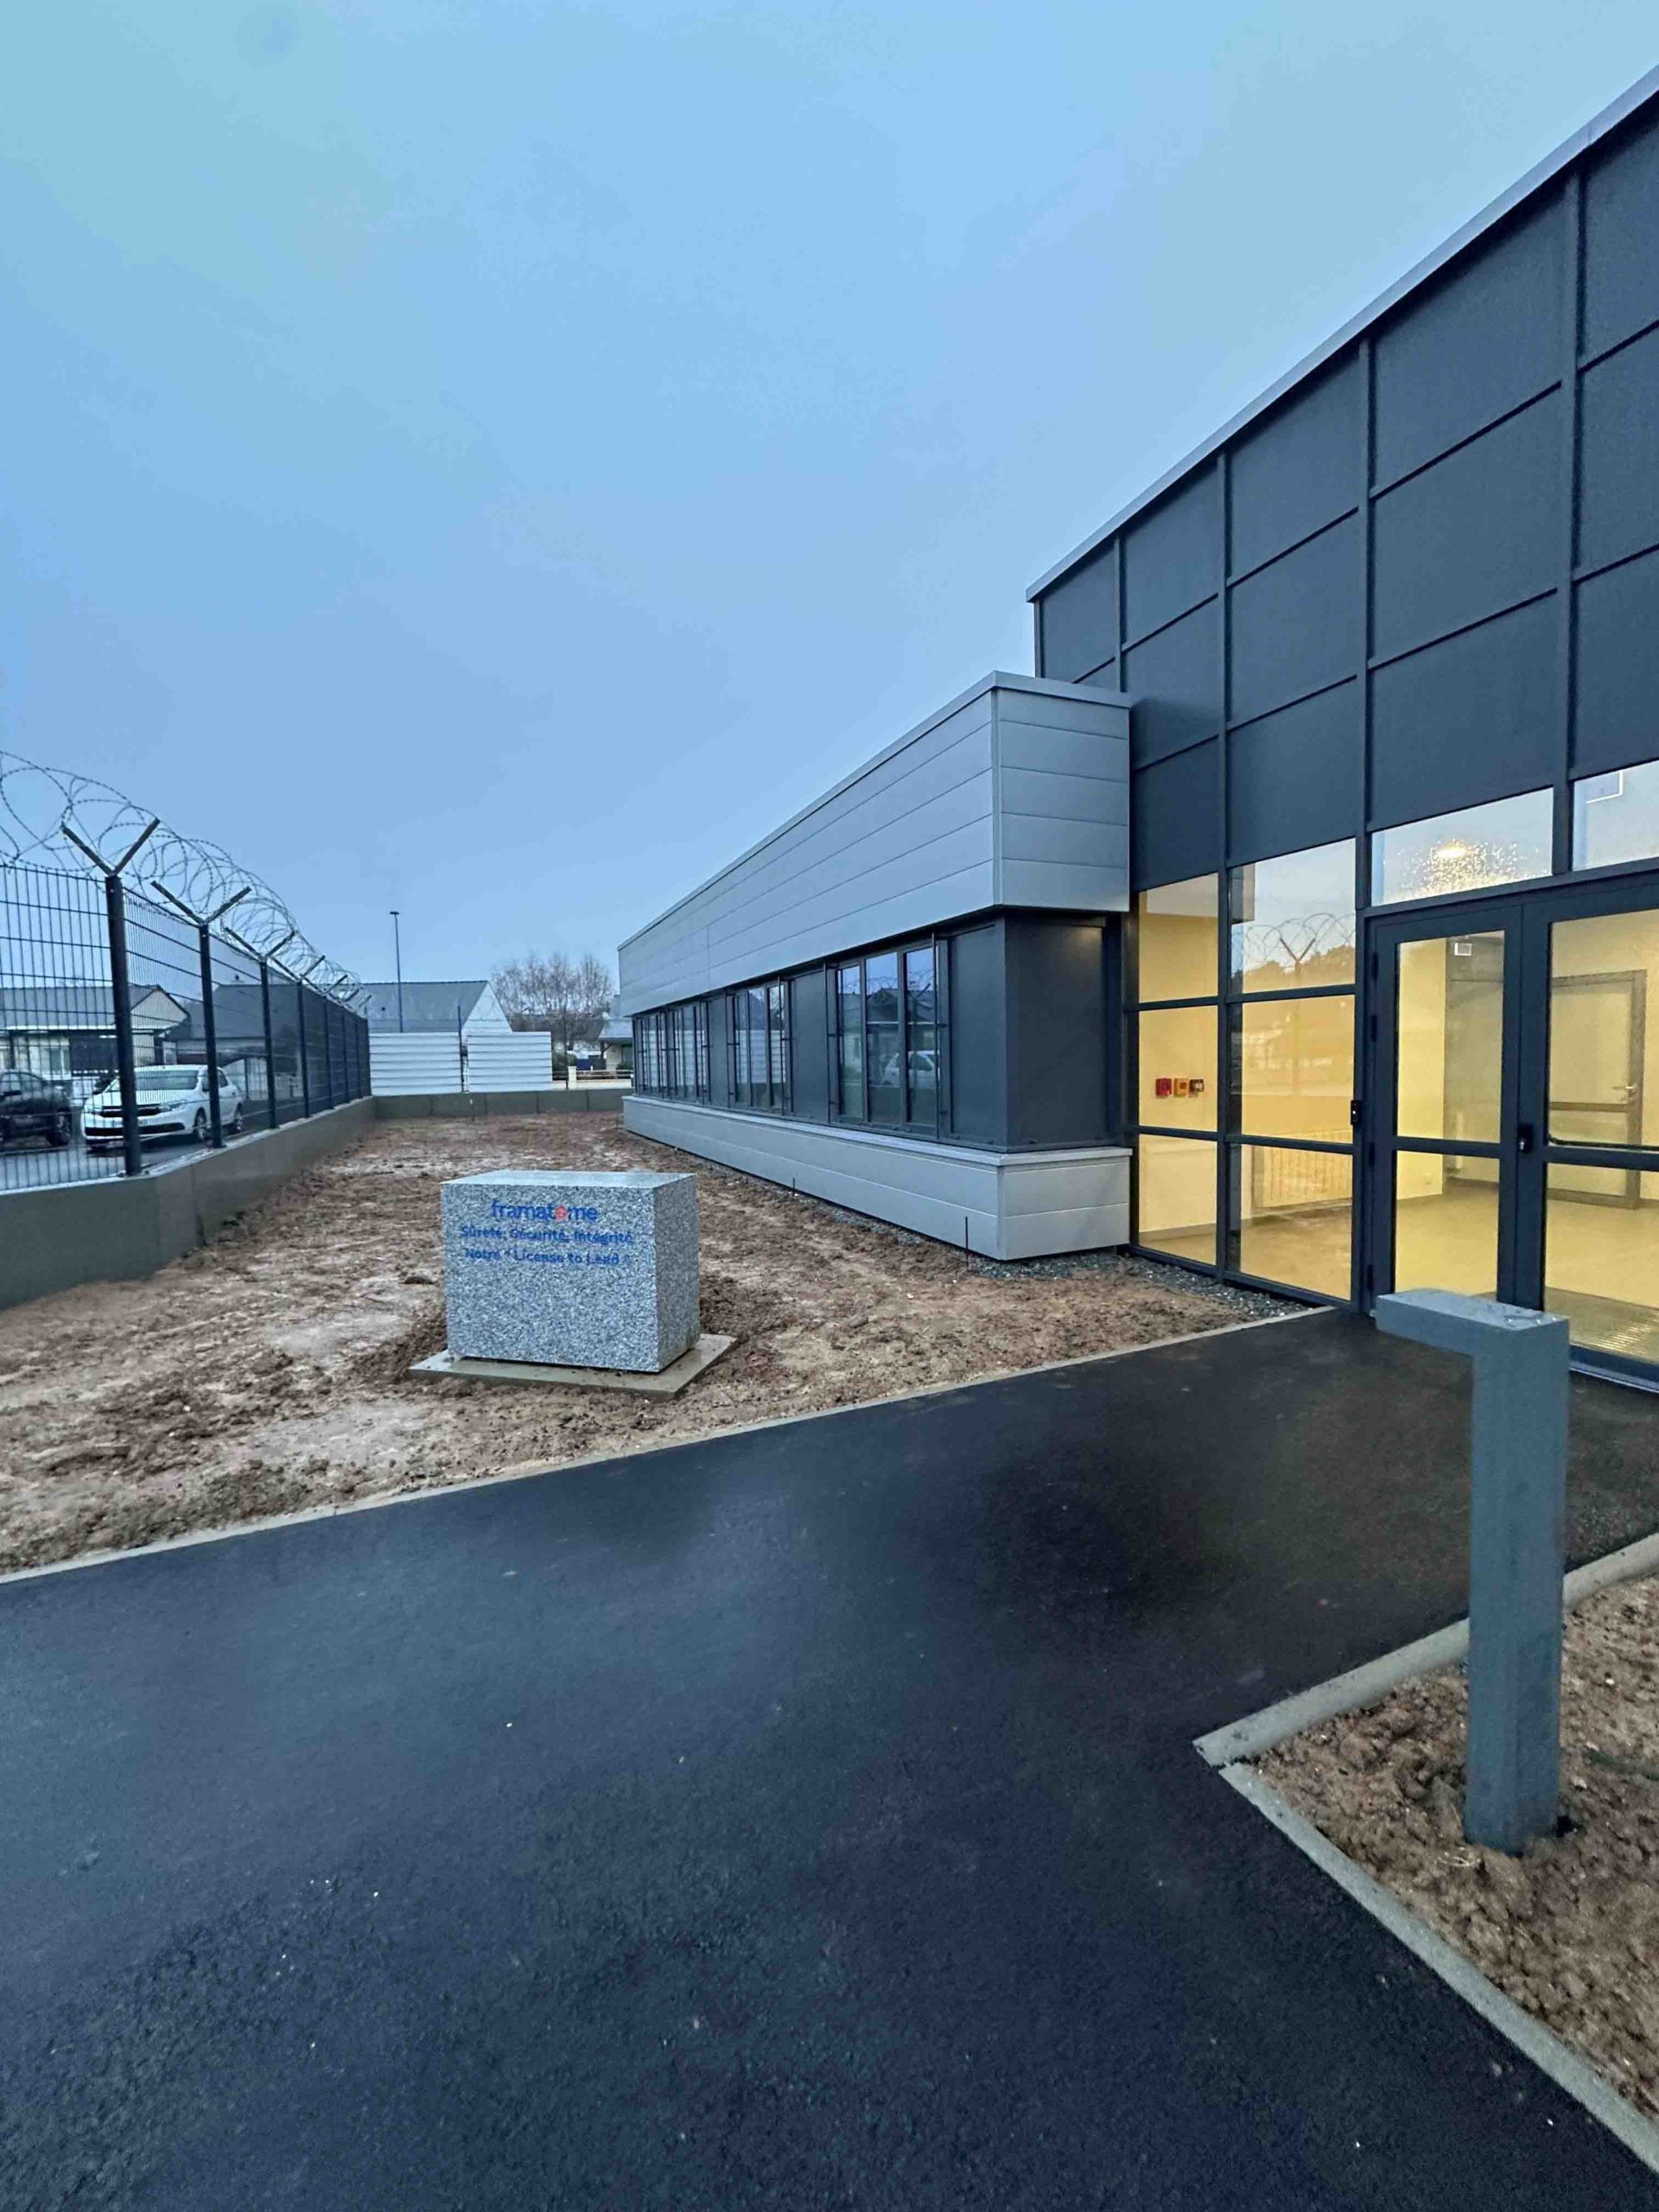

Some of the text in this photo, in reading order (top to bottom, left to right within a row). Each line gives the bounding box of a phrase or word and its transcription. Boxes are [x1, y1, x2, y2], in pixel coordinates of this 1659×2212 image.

[491, 1198, 599, 1221] framatome
[465, 1248, 501, 1261] Notre
[568, 1251, 582, 1264] to
